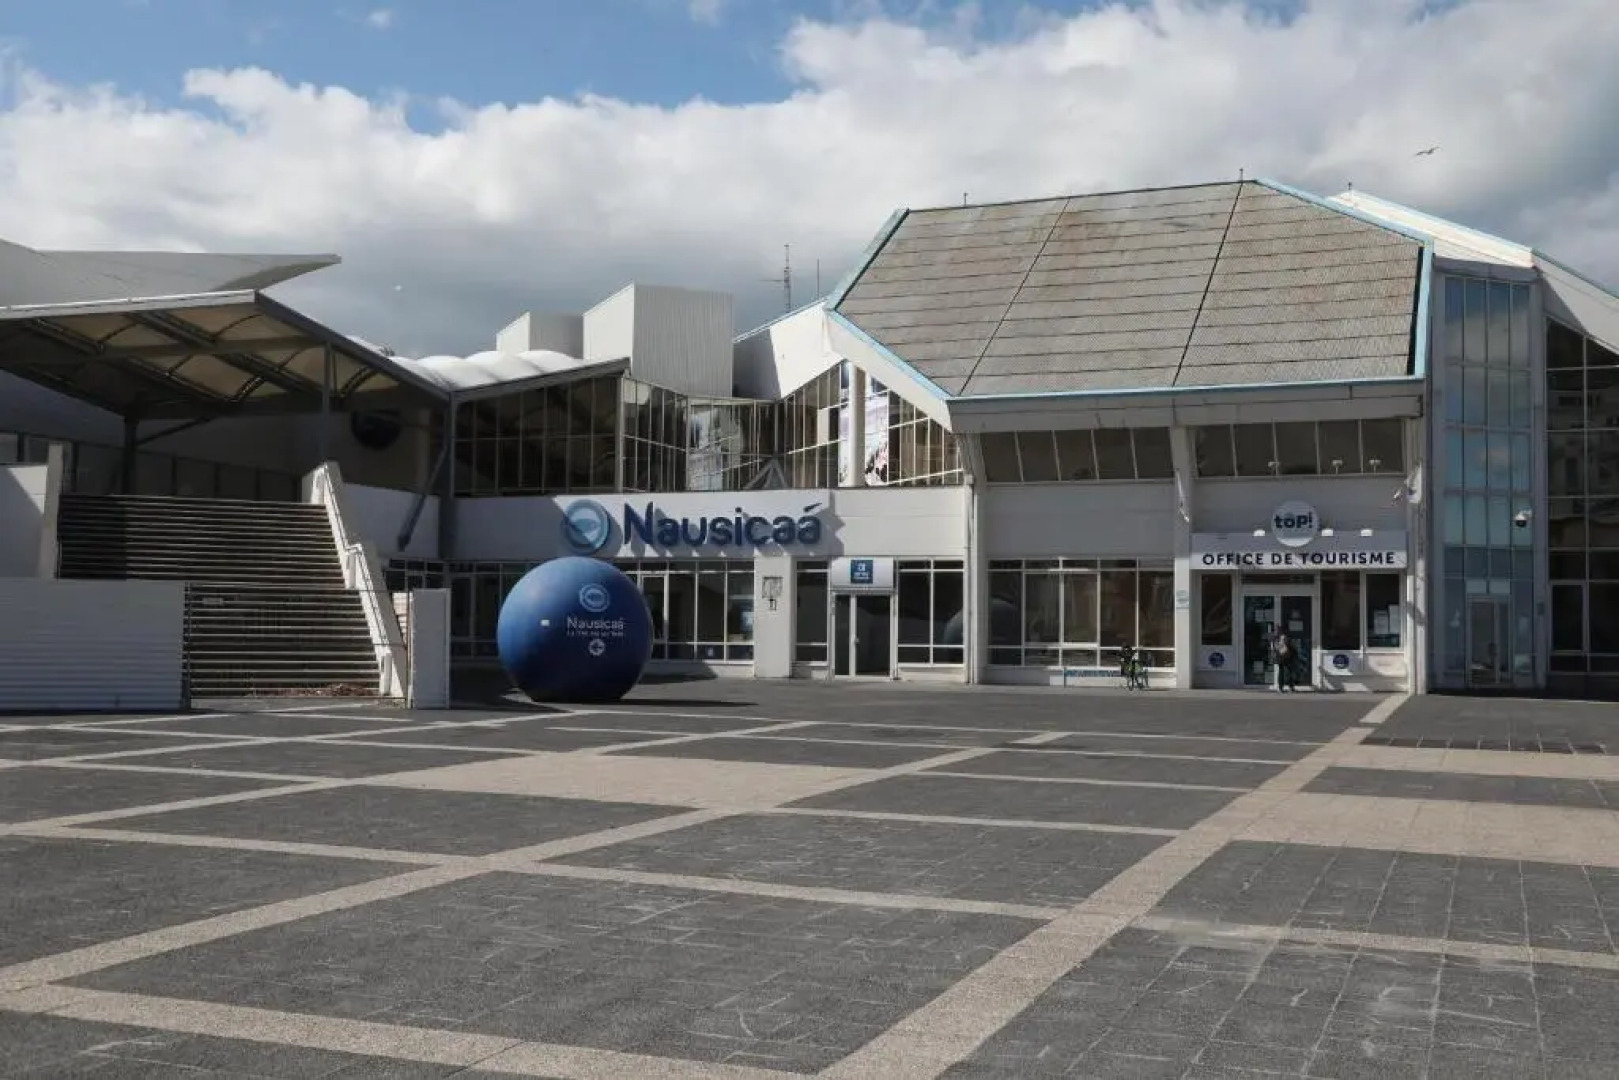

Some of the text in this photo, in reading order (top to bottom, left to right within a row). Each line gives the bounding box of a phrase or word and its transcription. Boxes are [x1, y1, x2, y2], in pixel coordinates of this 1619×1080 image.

[624, 501, 823, 547] Nausicaá
[1274, 512, 1314, 529] top!
[1202, 552, 1395, 566] OFFICE DE TOURISME
[566, 615, 625, 630] Nausicaá
